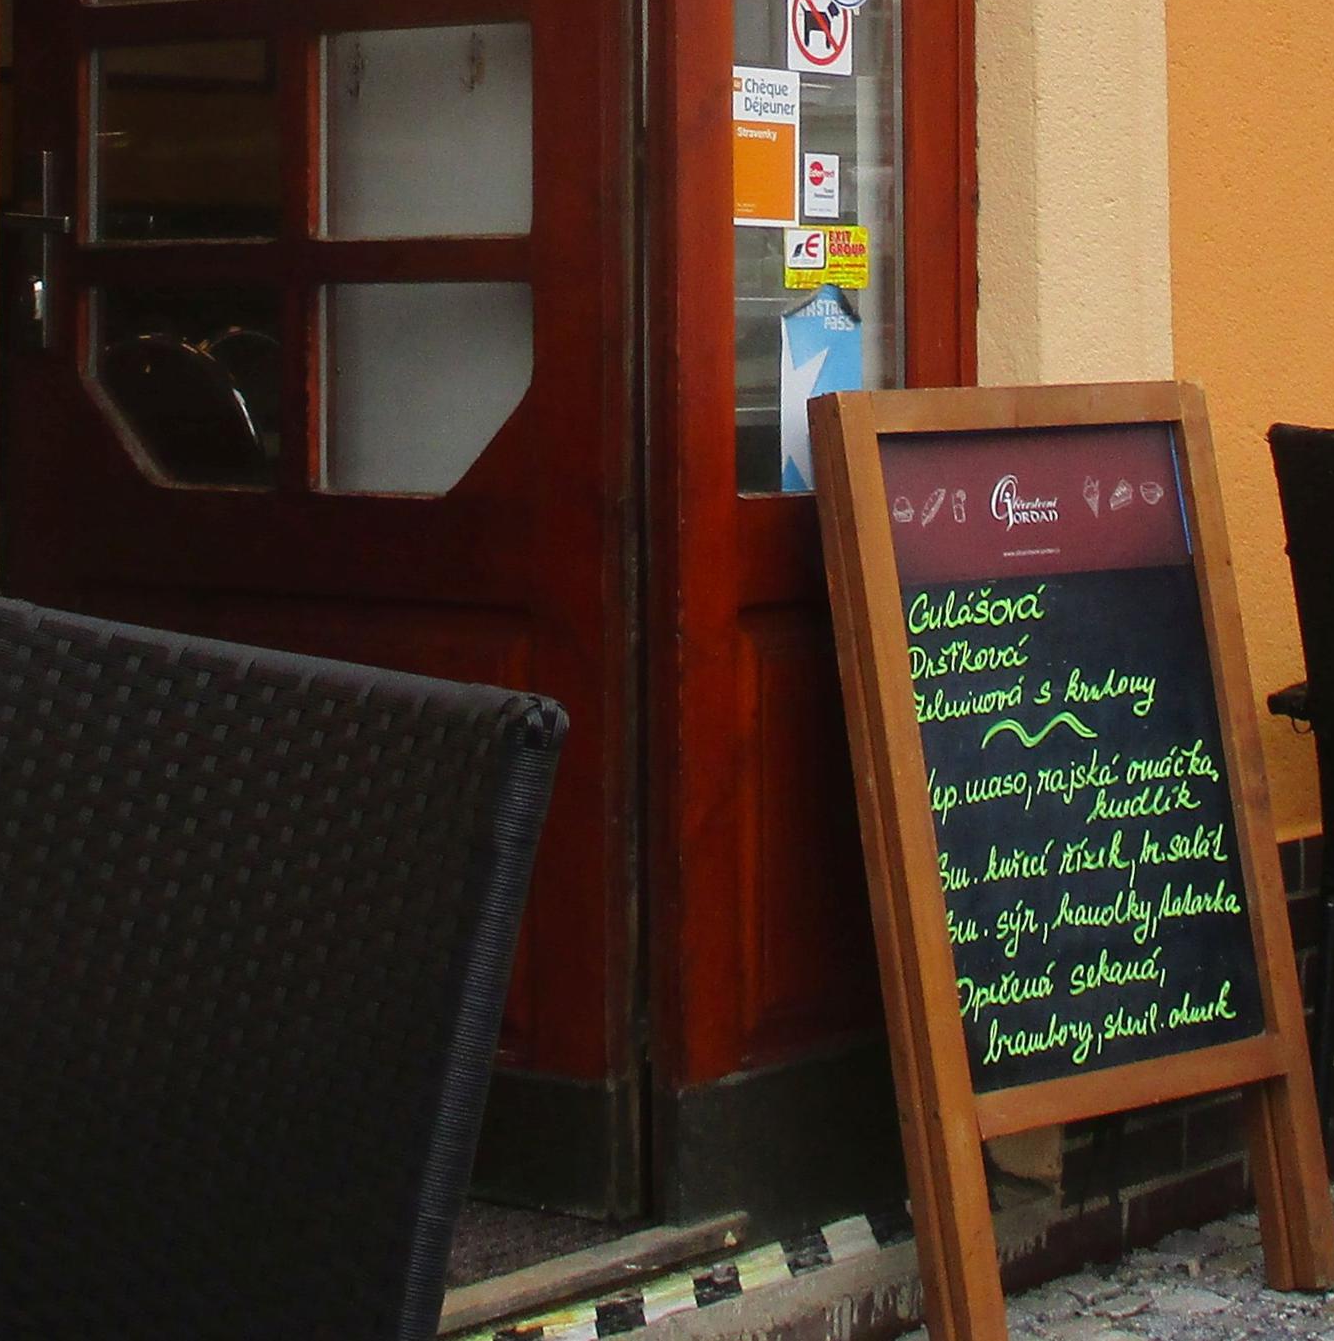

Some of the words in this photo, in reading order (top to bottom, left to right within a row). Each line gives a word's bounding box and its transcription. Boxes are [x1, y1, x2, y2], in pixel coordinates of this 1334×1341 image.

[744, 78, 789, 98] Chèque
[744, 96, 796, 116] Déjeuner
[828, 231, 852, 243] EXIT
[828, 243, 866, 257] GROUP
[1033, 679, 1052, 704] s
